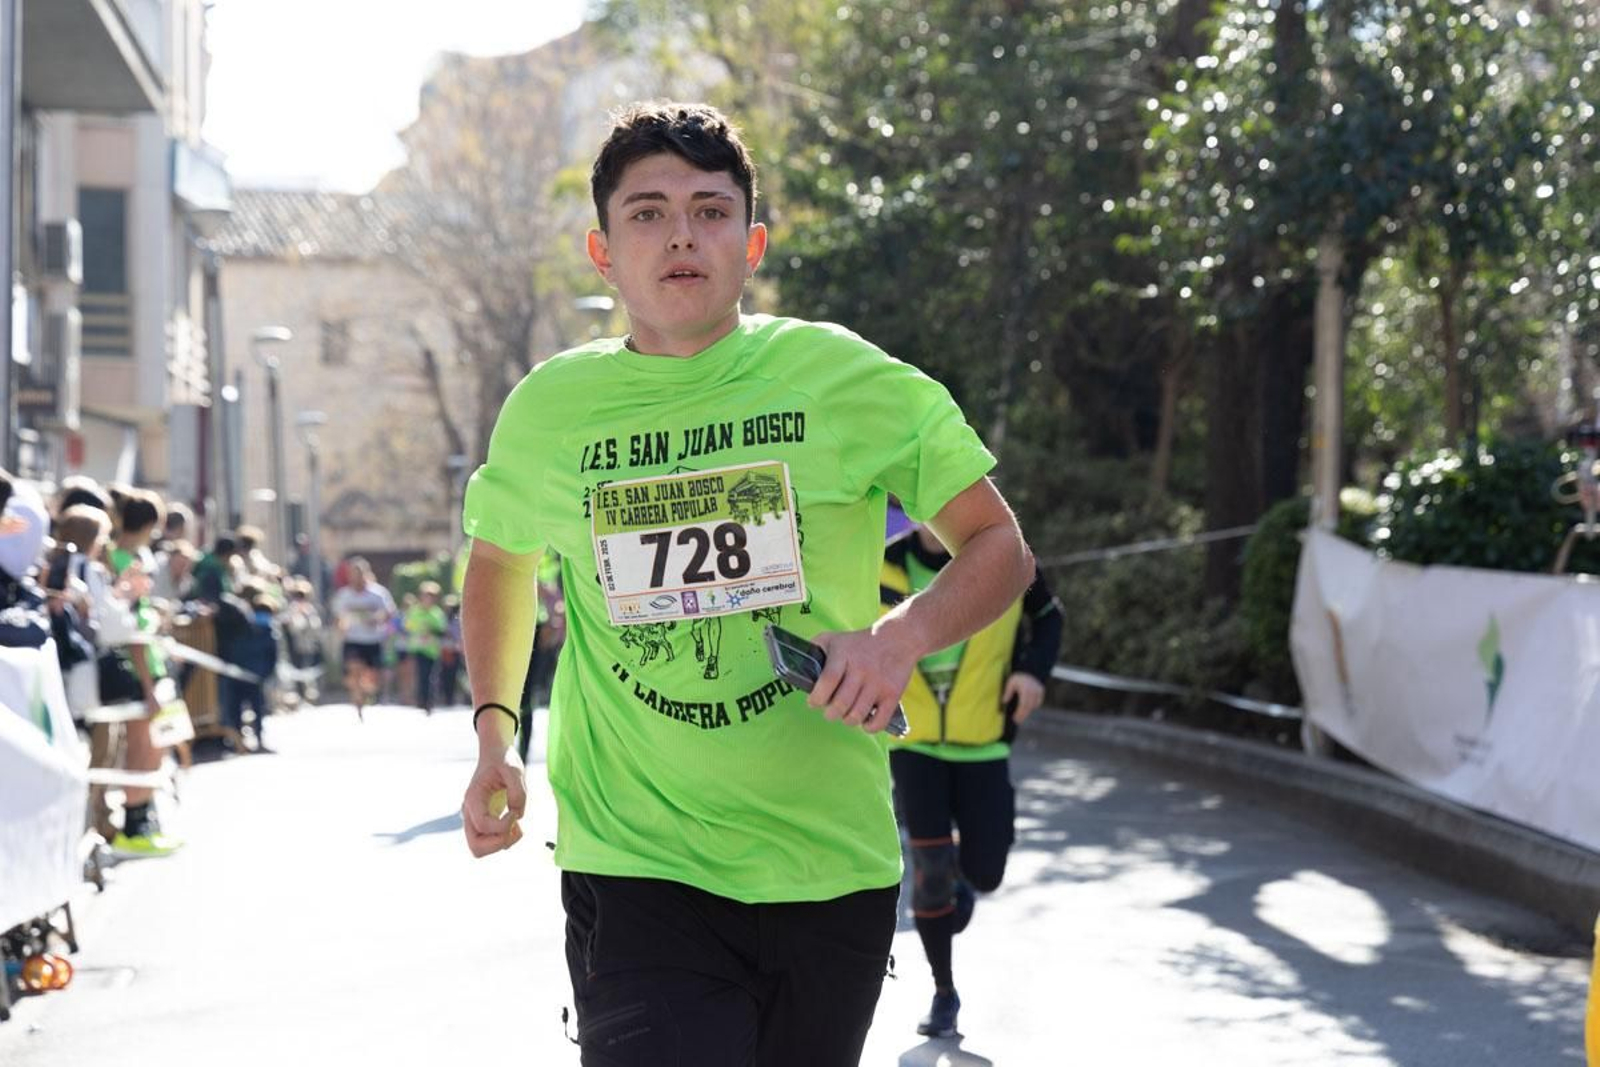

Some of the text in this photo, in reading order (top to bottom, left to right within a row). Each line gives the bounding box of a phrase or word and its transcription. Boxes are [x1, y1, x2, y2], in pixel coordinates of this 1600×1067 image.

[580, 411, 805, 473] I.E.S. SAN JUAN BOSCO
[597, 490, 623, 509] I.E.S.
[625, 486, 649, 505] SAN
[654, 482, 685, 502] JUAN
[687, 475, 725, 498] BOSCO
[606, 496, 719, 526] IV CARRERA POPULAR
[639, 521, 751, 588] 728
[740, 586, 761, 597] daño
[762, 581, 796, 592] cerebral
[736, 678, 801, 722] POPU
